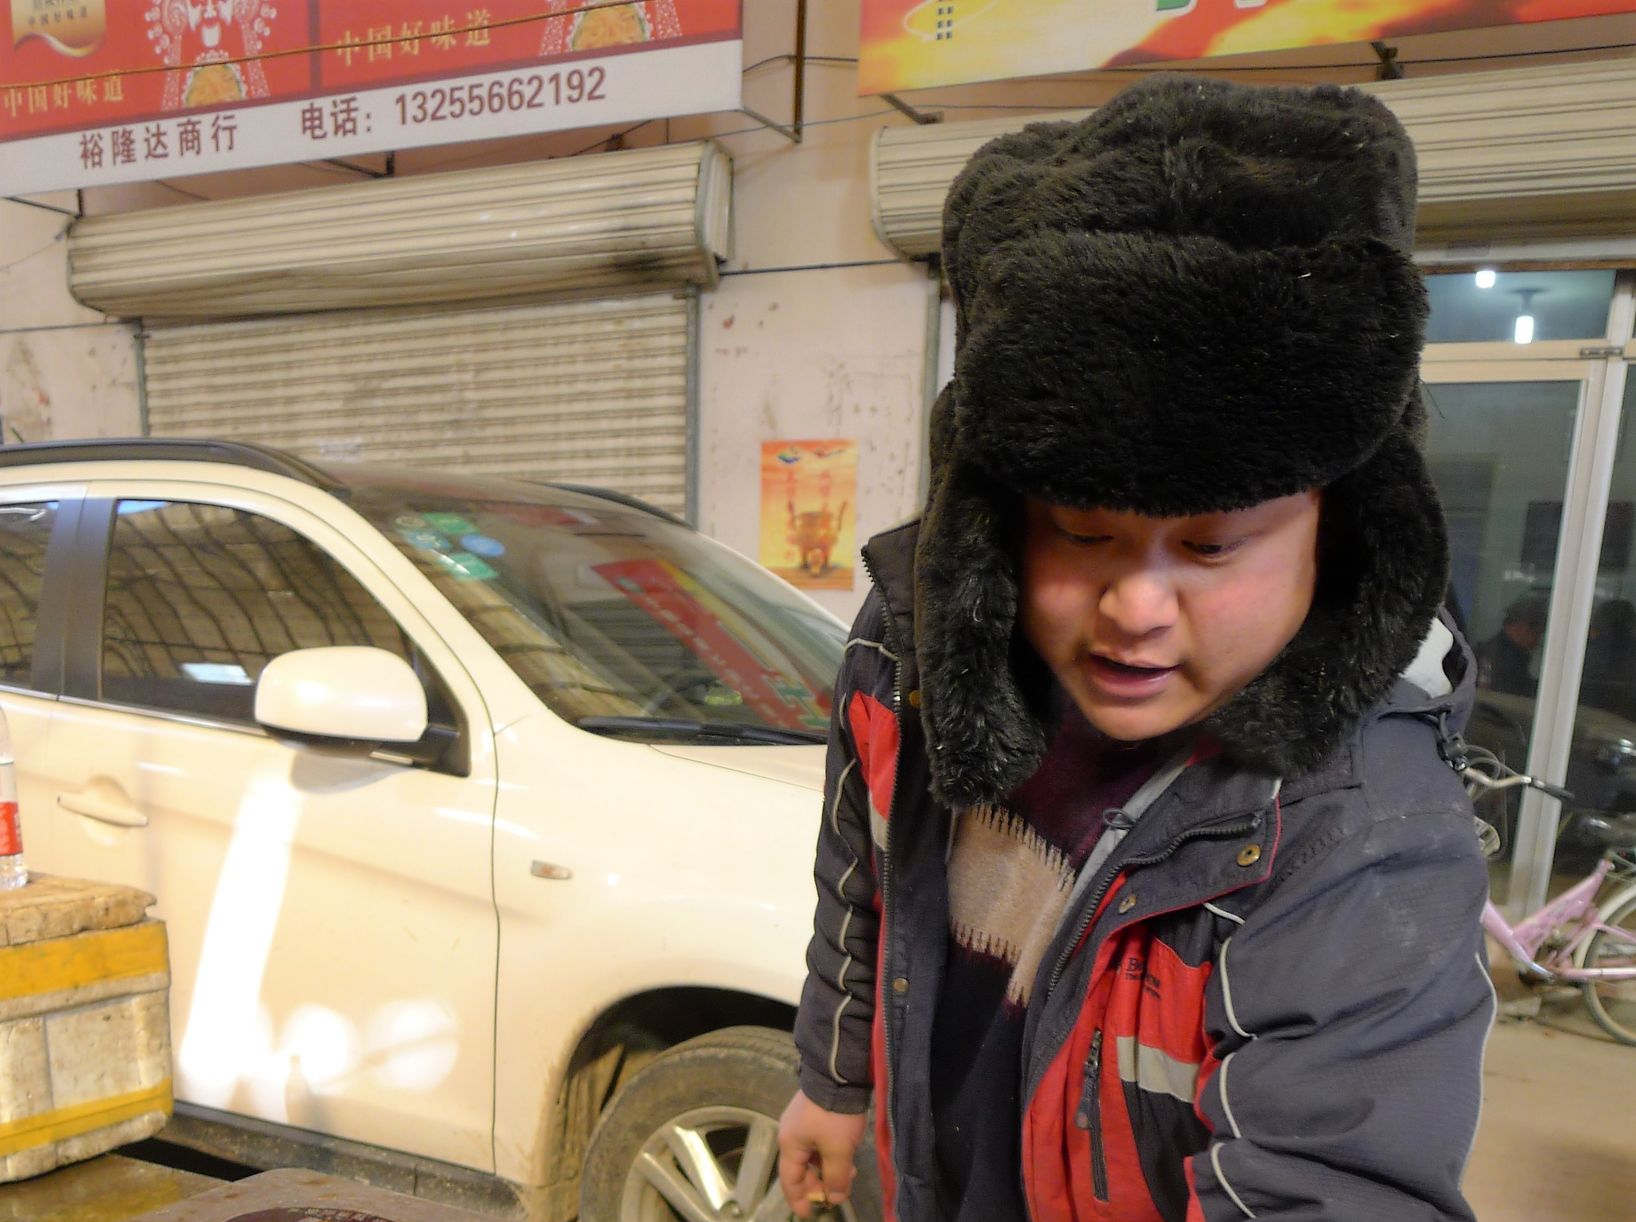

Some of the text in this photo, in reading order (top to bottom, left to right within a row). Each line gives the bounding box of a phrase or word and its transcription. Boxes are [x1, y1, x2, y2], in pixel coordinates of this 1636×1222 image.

[336, 9, 491, 67] 中国好味道
[80, 114, 238, 169] 裕隆达商行
[395, 66, 606, 126] 13255662192
